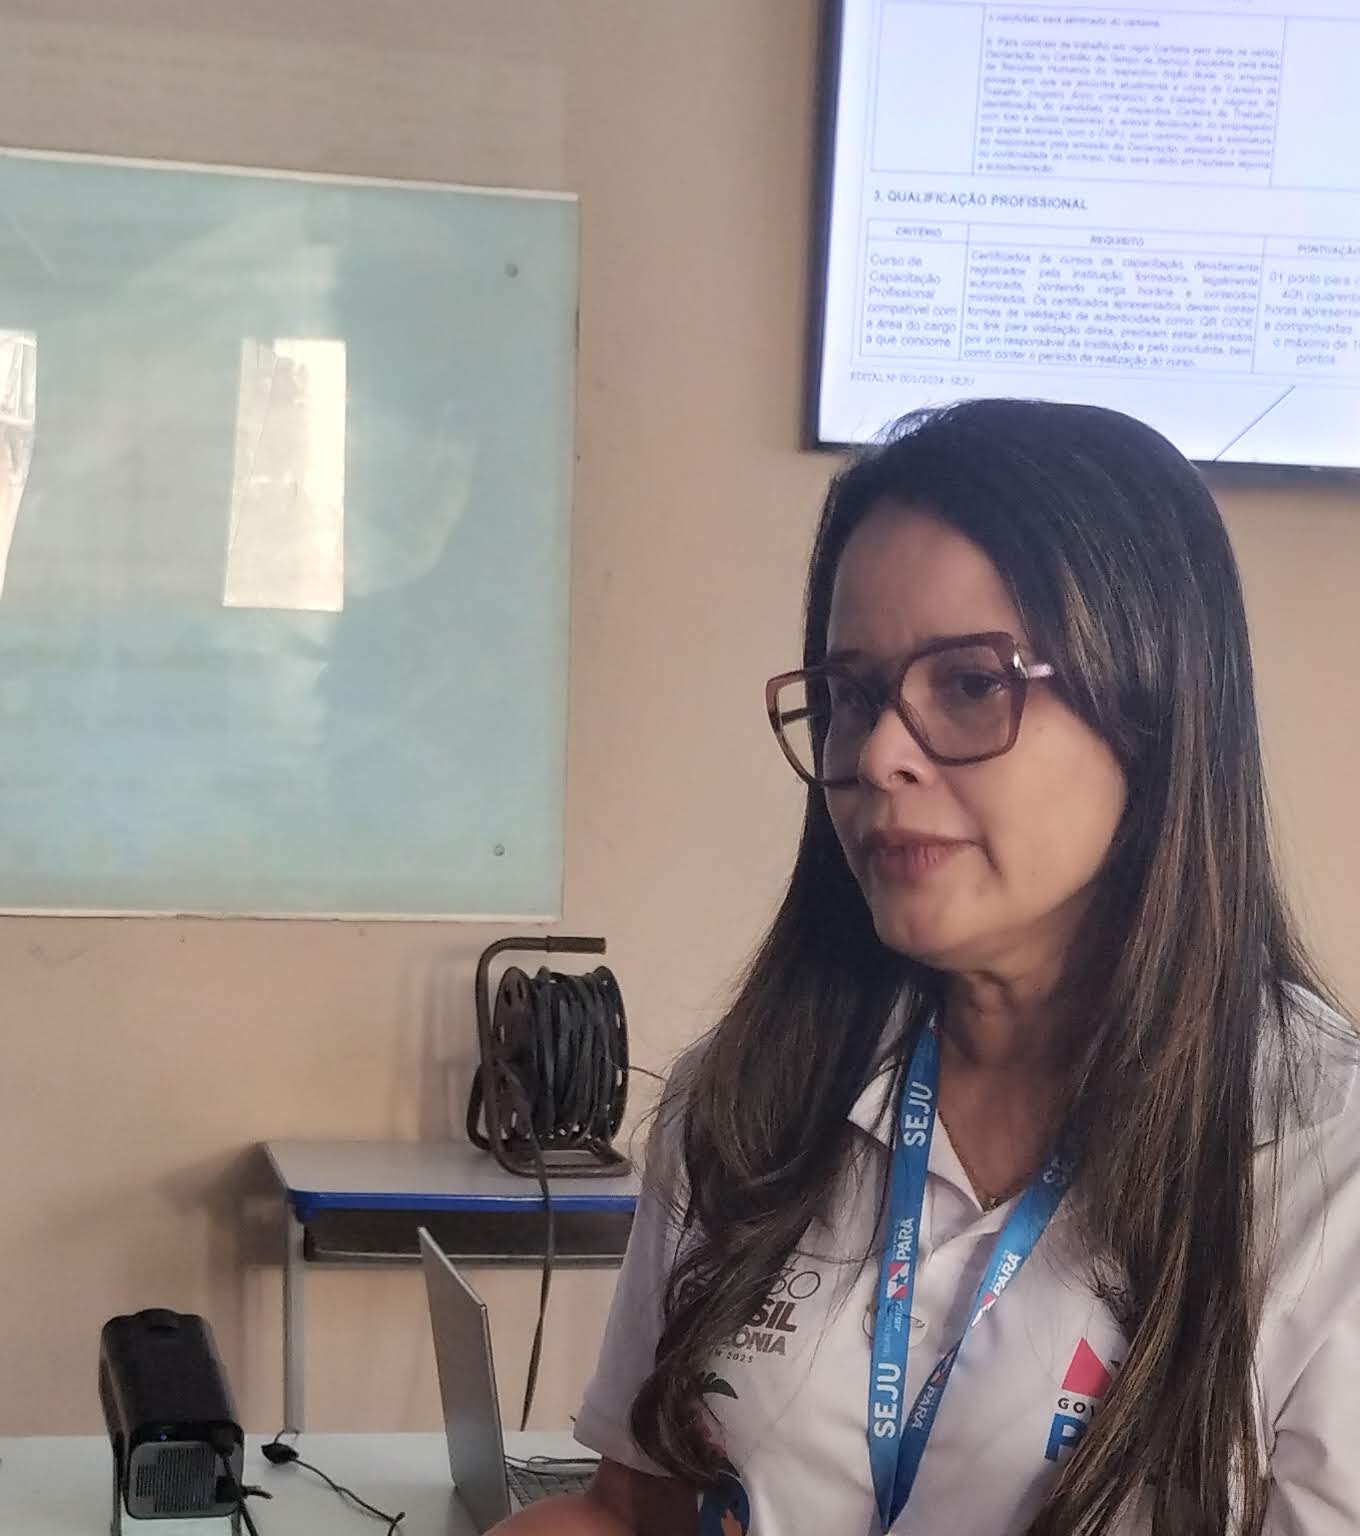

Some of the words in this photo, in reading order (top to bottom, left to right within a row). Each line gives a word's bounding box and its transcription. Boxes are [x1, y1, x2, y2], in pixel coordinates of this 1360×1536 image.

[887, 188, 987, 208] QUALIFICAÇÃO
[990, 192, 1088, 210] PROFISSIONAL
[869, 252, 905, 266] Curso
[904, 1081, 934, 1147] SEJU
[750, 1298, 798, 1333] SIL
[873, 1363, 902, 1438] SEJU
